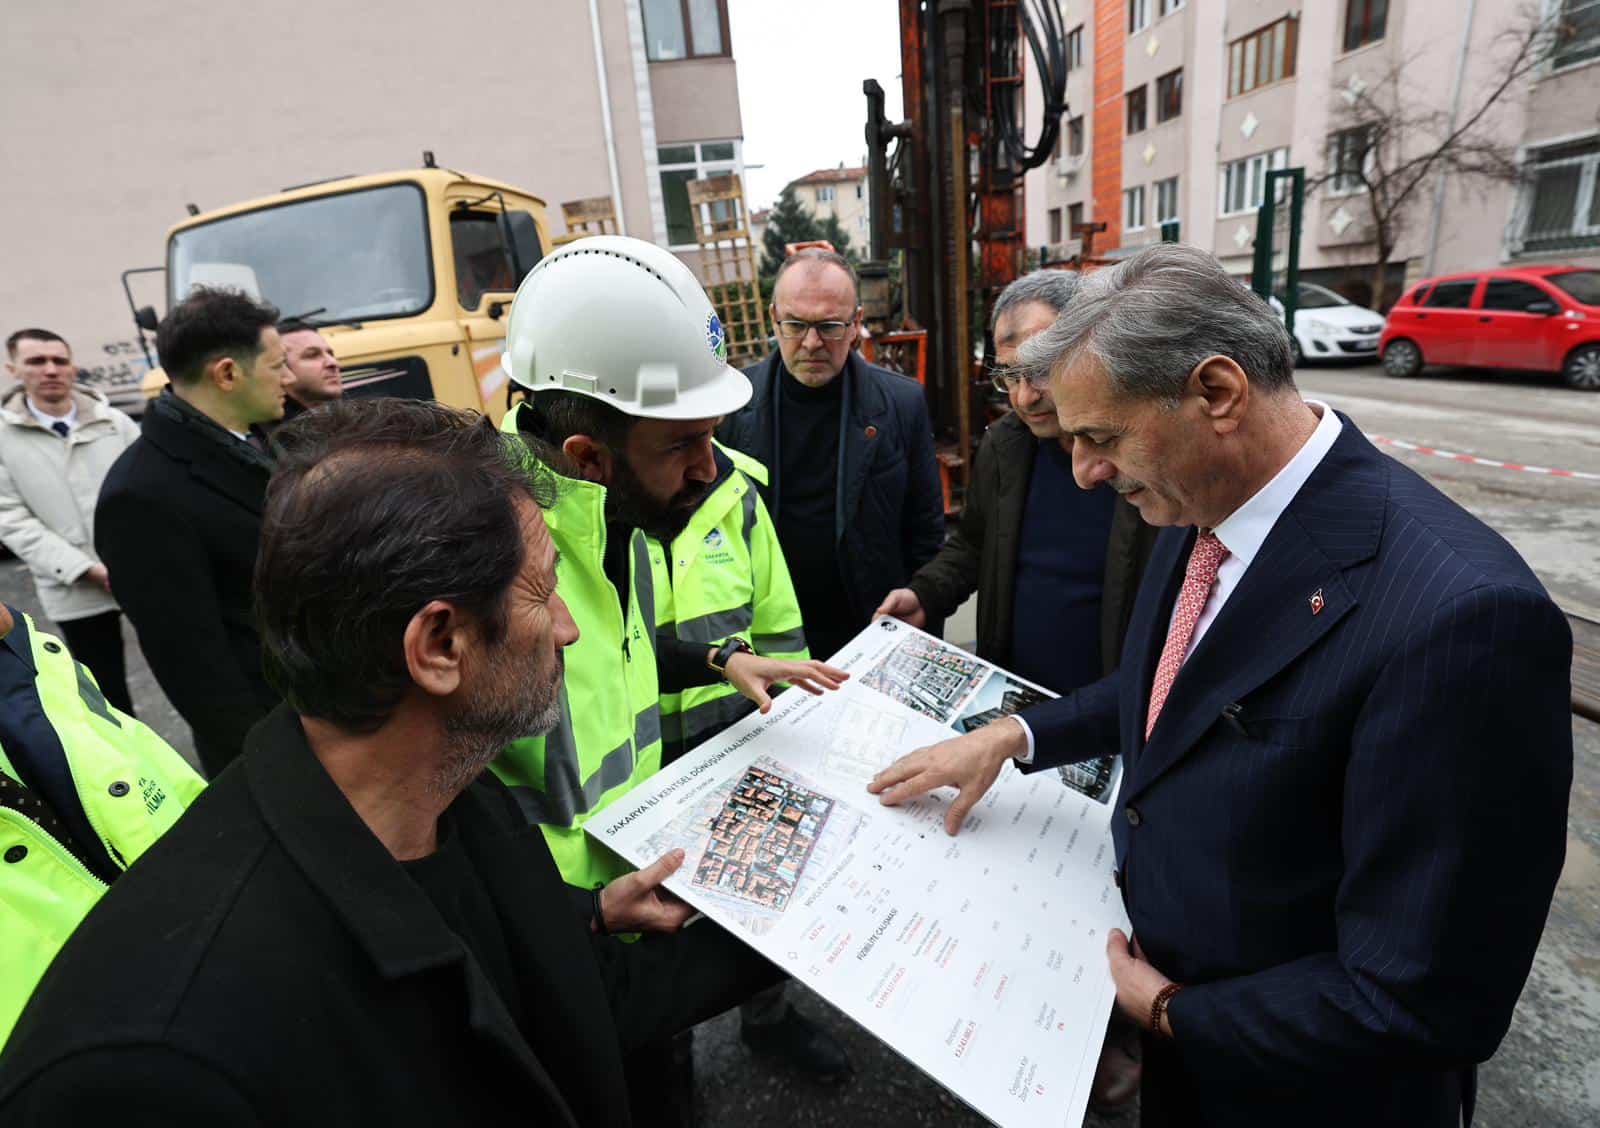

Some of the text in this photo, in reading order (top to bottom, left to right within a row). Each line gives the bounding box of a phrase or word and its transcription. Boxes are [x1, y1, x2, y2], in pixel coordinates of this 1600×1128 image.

[606, 805, 648, 837] SAKARYA
[645, 795, 660, 808] İLİ
[659, 776, 692, 799] KENTSEL
[689, 751, 726, 778] DÖNÜŞÜM
